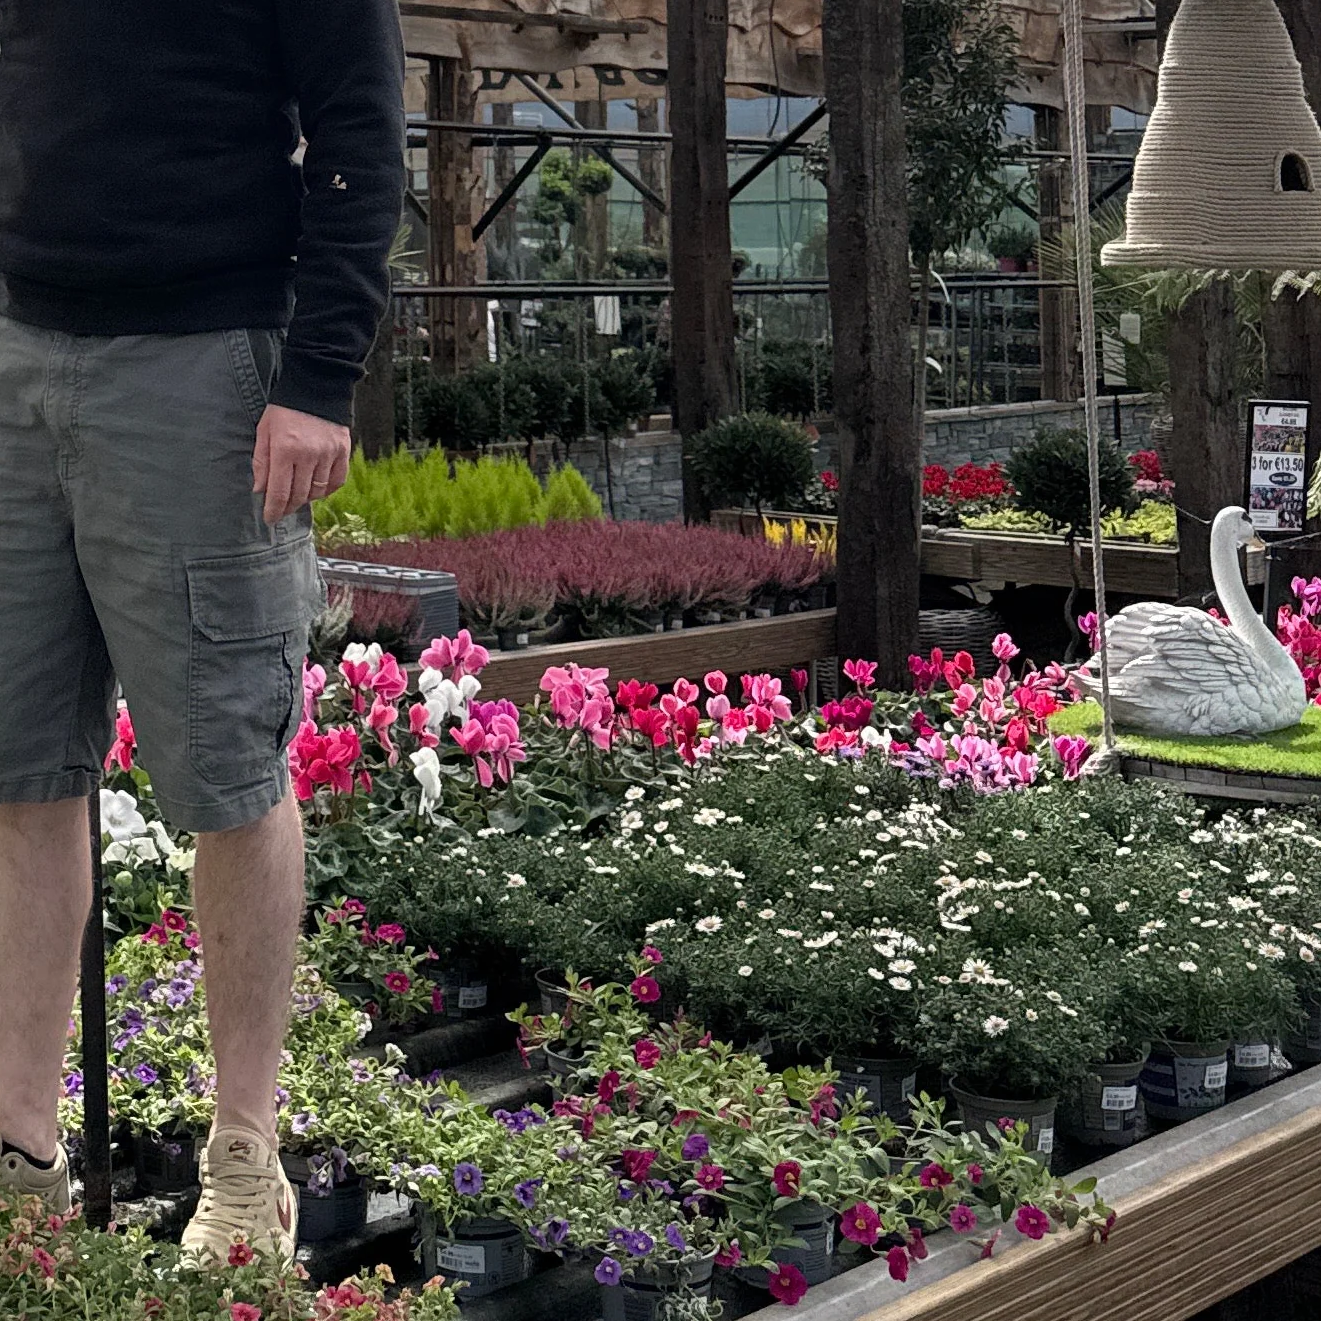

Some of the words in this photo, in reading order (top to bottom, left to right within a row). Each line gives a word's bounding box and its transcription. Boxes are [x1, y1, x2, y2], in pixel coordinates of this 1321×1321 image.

[1252, 457, 1256, 471] 3
[1259, 456, 1273, 471] for
[1274, 457, 1304, 472] €13.50
